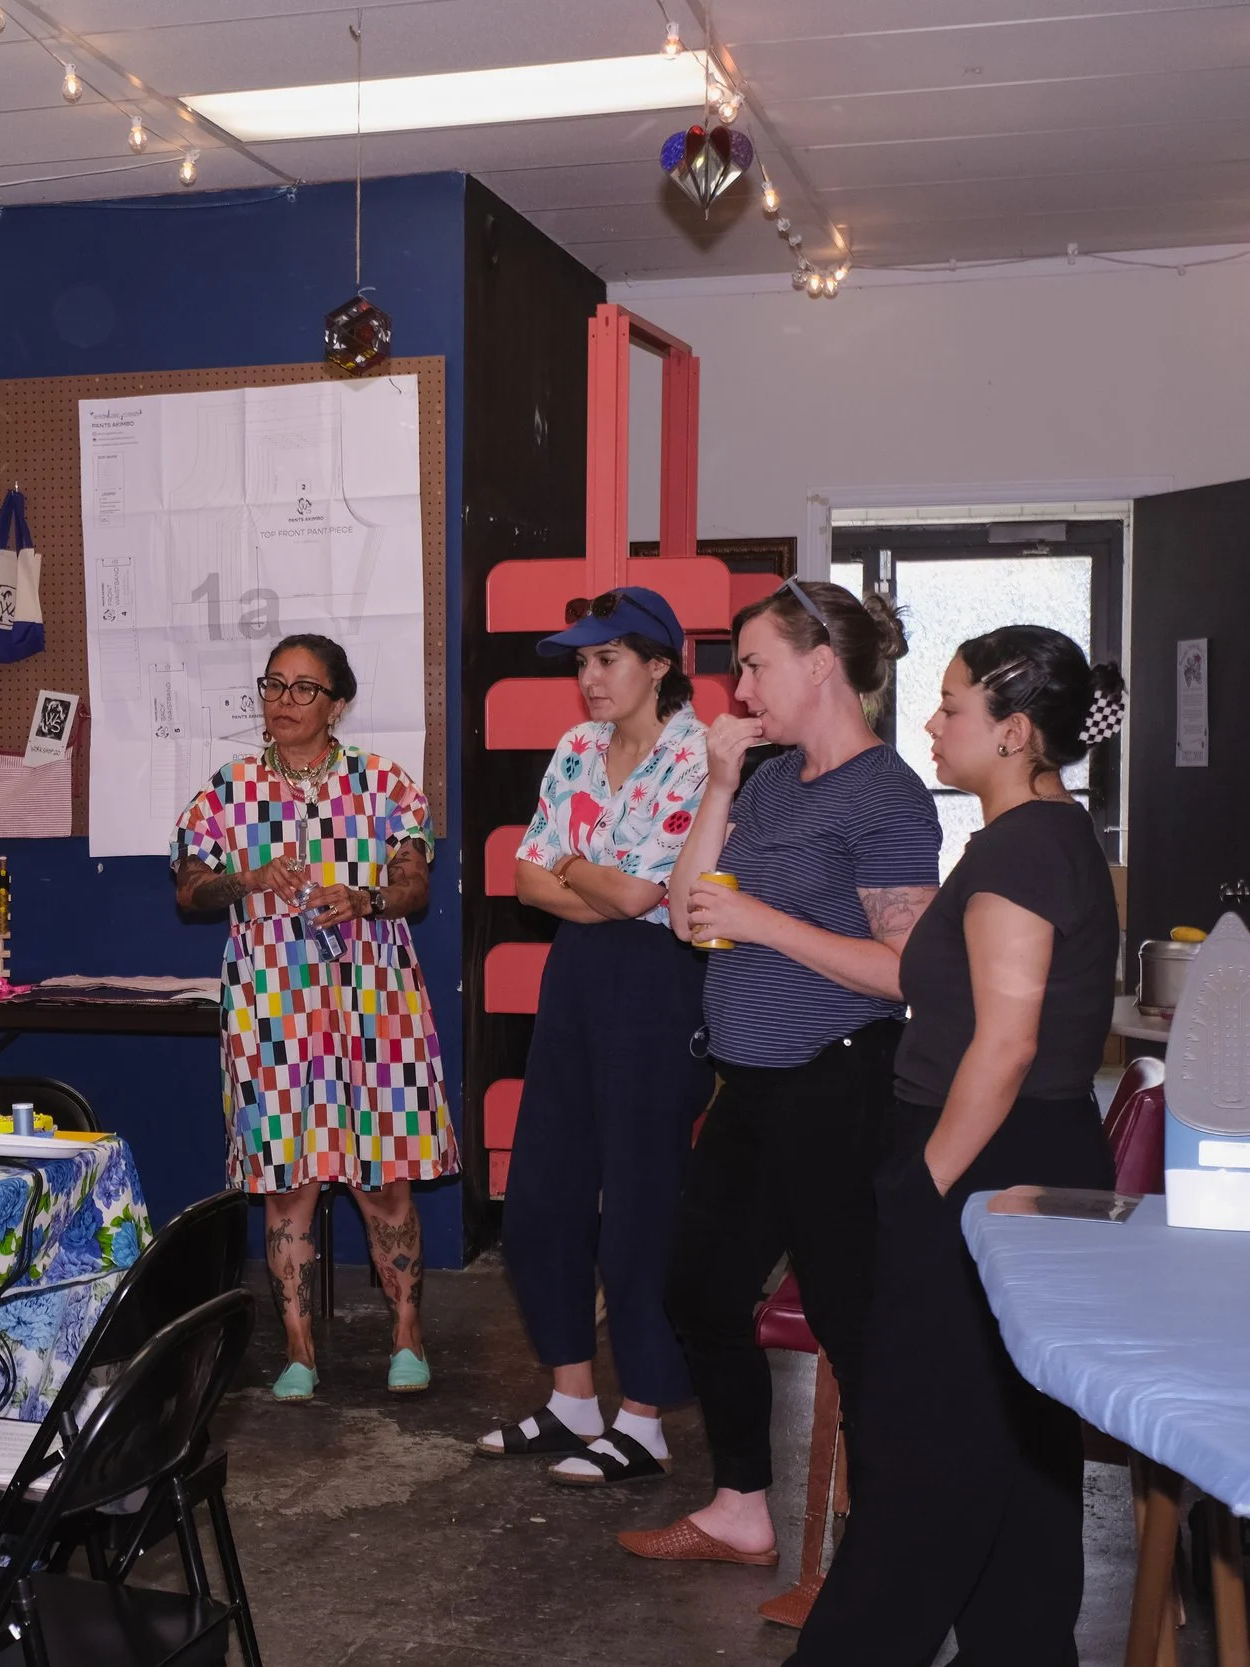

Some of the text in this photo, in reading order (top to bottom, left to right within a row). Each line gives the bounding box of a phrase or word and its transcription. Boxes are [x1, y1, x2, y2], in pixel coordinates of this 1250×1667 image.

[260, 526, 354, 539] TOP FRONT PANT PIECE
[191, 573, 283, 641] 1a
